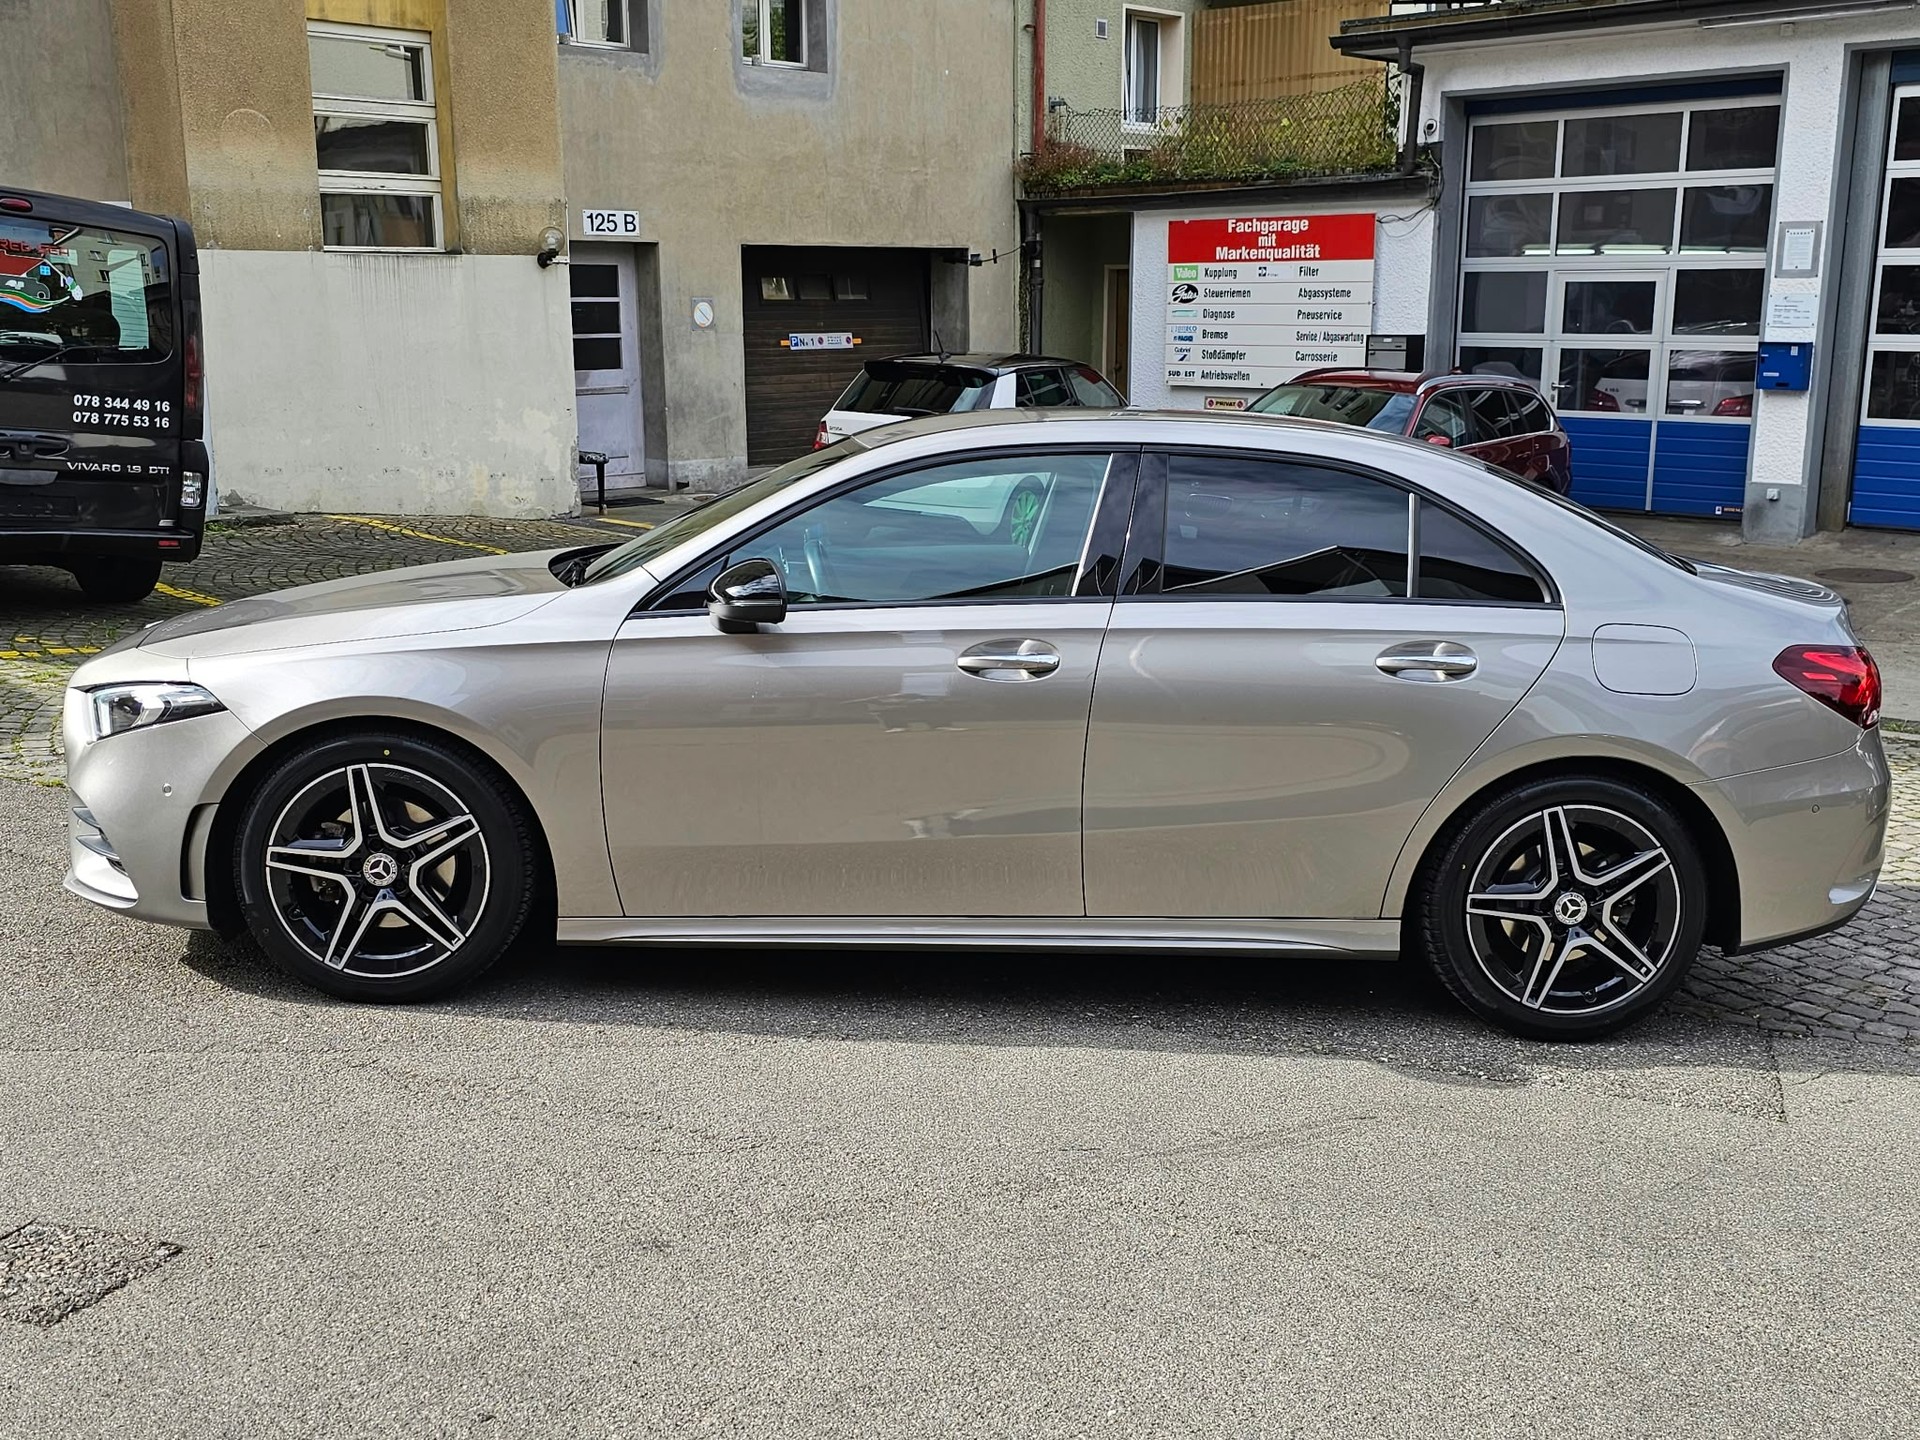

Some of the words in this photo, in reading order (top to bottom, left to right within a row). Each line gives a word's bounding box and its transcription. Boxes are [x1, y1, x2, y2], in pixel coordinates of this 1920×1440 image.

[587, 213, 618, 232] 125
[624, 214, 637, 232] B
[1227, 218, 1309, 234] Fachgarage
[1258, 233, 1276, 247] mit
[1215, 243, 1320, 262] Markenqualität
[1204, 267, 1238, 280] Kupplung
[1298, 266, 1319, 277] Filter
[1203, 287, 1252, 299] Steuerriemen
[1297, 287, 1352, 301] Abgassysteme
[1202, 308, 1236, 321] Diagnose
[1296, 309, 1343, 321] Pneuservice
[1202, 329, 1229, 340] Bremse
[1295, 330, 1318, 343] Service
[1322, 331, 1365, 345] Abgaswartung
[1201, 349, 1247, 362] Stoßdämpfer
[1295, 351, 1338, 362] Carrosserie
[1200, 369, 1251, 381] Antriebswellen
[73, 394, 101, 408] 078
[104, 396, 130, 410] 344
[133, 399, 150, 411] 49
[154, 400, 170, 412] 16
[72, 411, 100, 424] 078
[103, 413, 130, 426] 775
[132, 415, 150, 427] 53
[153, 416, 170, 428] 16
[66, 461, 122, 473] VIVARO
[148, 466, 170, 475] DTI
